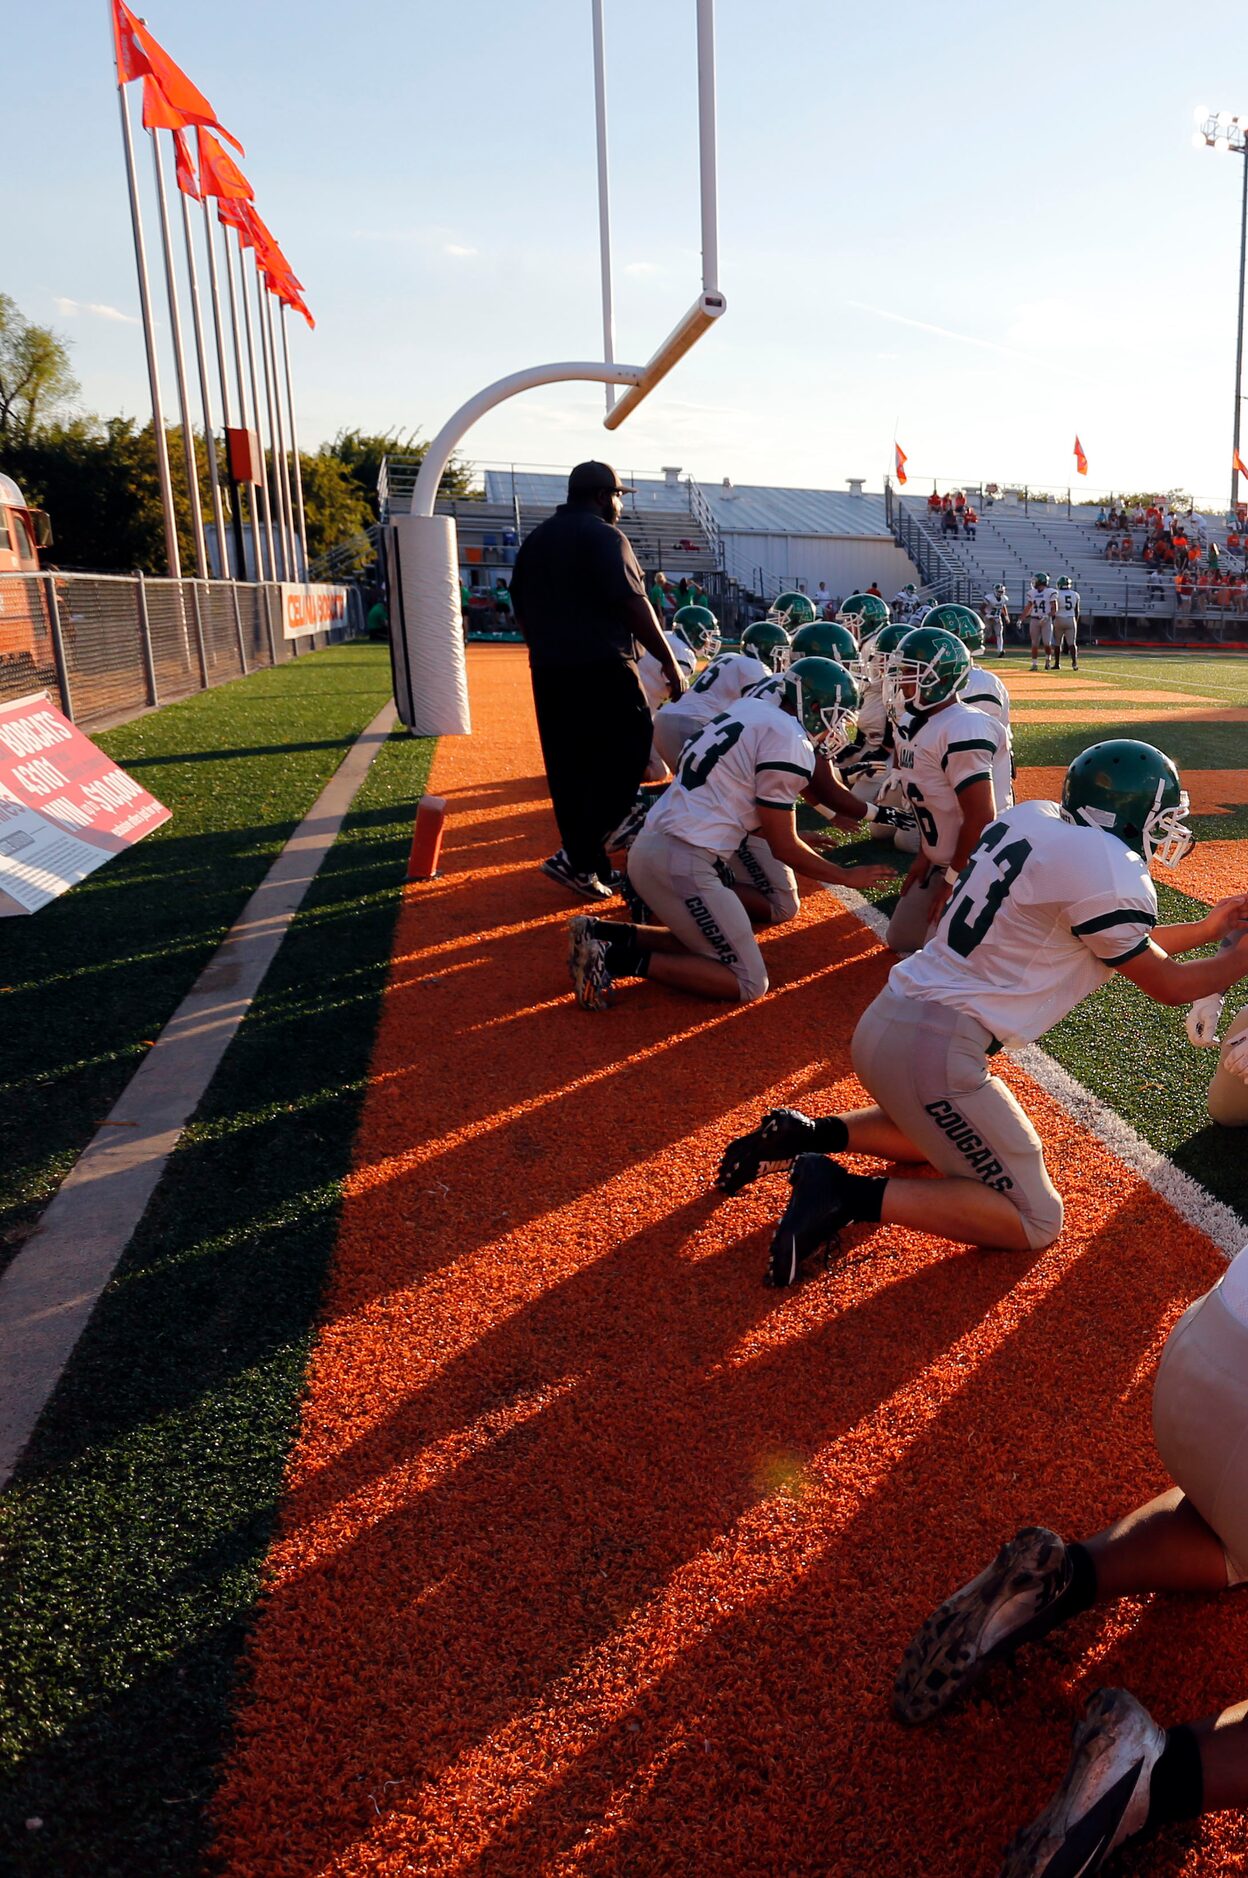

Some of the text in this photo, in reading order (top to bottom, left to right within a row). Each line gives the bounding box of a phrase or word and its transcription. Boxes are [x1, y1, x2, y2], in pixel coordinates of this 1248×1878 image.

[938, 610, 978, 639] BA
[1064, 595, 1073, 611] 5
[0, 710, 73, 758] BOBCATS
[11, 756, 71, 797] 43101
[40, 796, 95, 832] WIN
[79, 769, 144, 815] $10,000
[685, 895, 739, 966] COUGARS
[925, 1099, 1014, 1192] COUGARS
